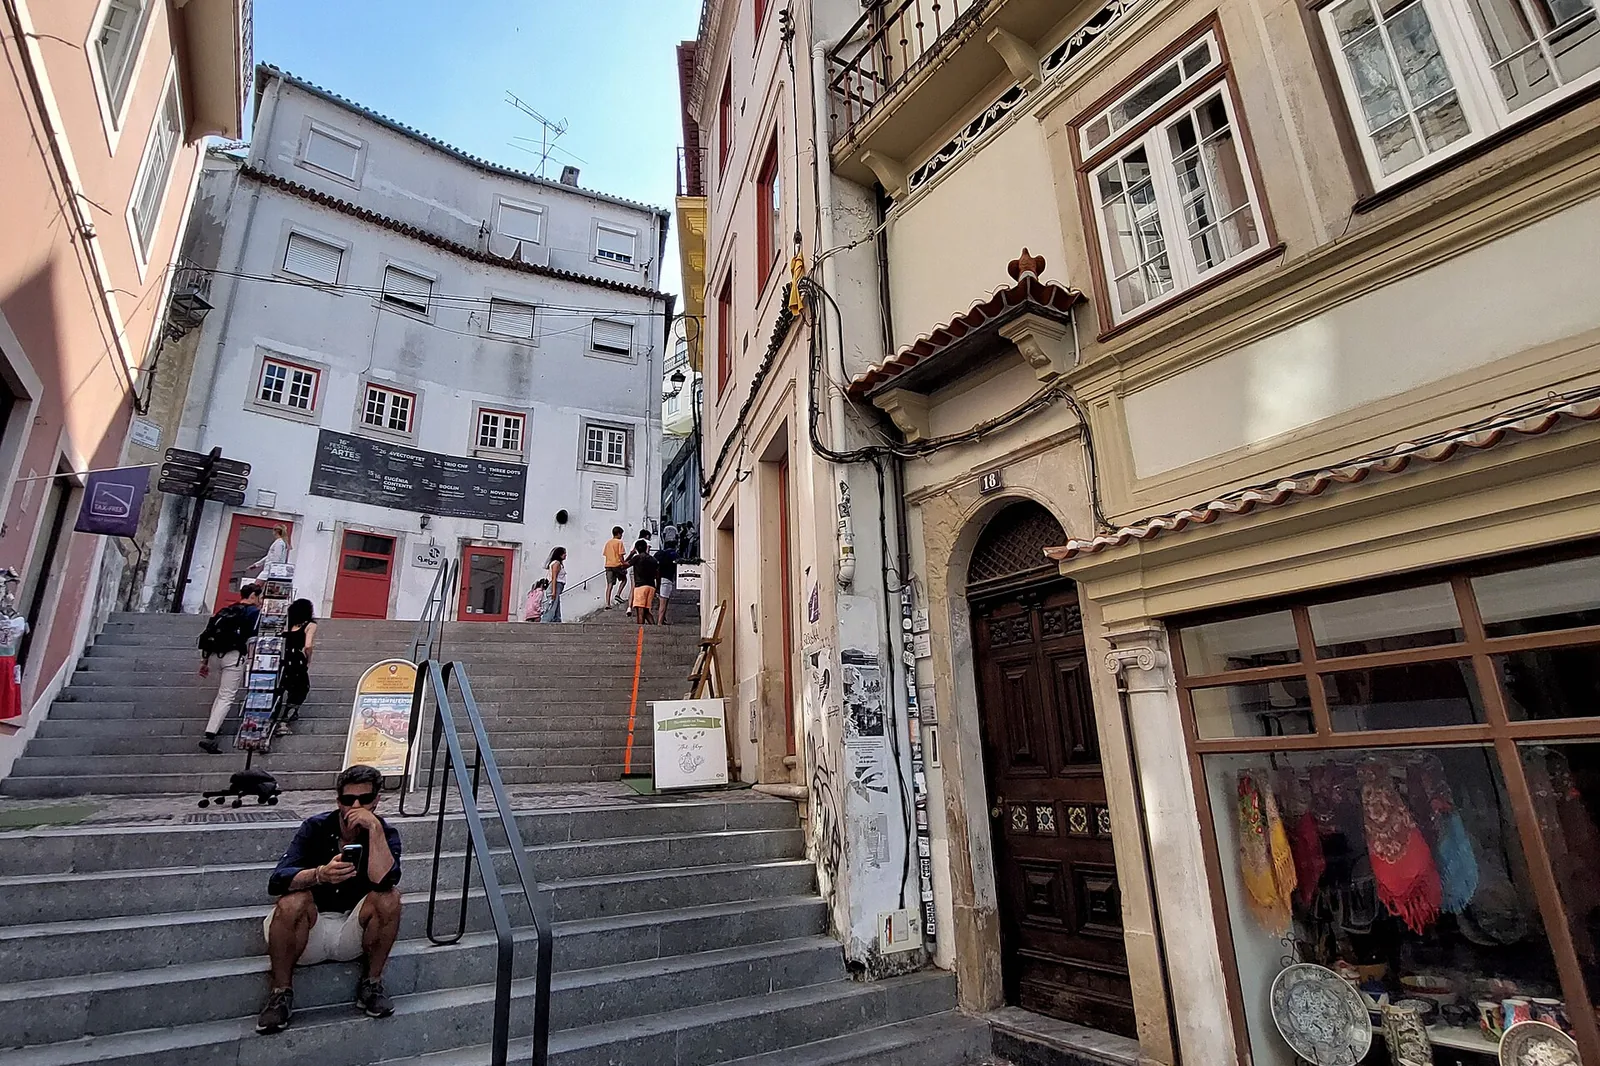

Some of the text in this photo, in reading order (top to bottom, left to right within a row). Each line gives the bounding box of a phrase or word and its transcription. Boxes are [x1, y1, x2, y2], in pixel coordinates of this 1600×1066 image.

[330, 448, 361, 459] ARTES
[383, 480, 413, 489] CONTENTE
[983, 473, 996, 490] 18
